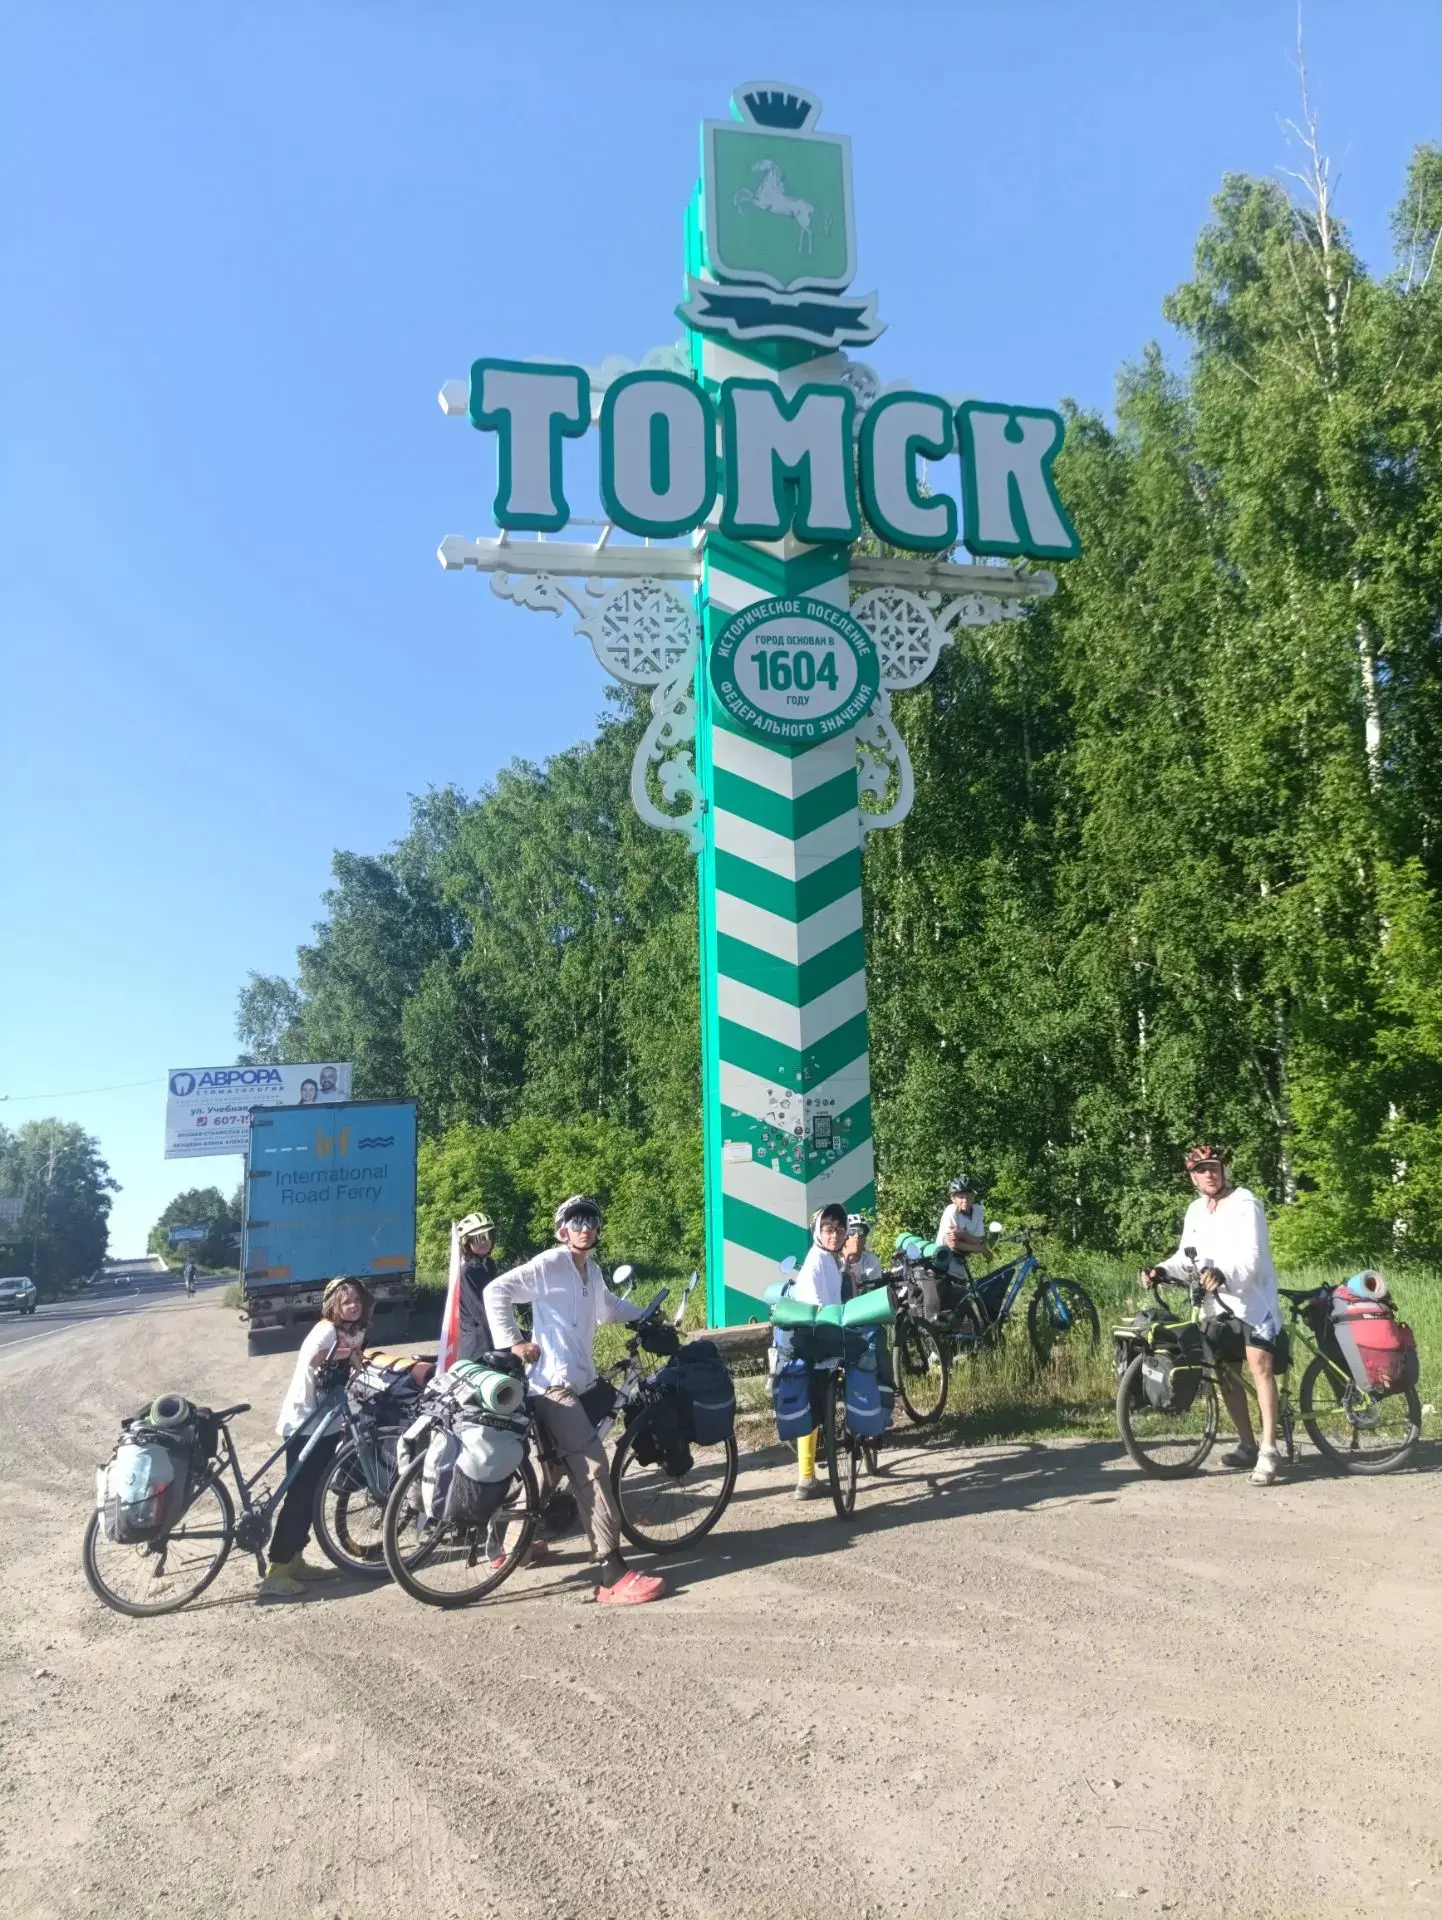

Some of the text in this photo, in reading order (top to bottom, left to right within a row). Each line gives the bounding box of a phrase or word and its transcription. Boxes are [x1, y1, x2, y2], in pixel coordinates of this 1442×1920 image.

[469, 357, 1082, 561] ТОМСК
[717, 601, 871, 658] ИСТОРИЧЕСКОЕ ПОСЕЛЕНИЕ
[755, 635, 835, 646] ГОРОД ОСНОВАН В
[751, 650, 839, 692] 1604
[720, 681, 872, 737] ФЕДЕРАЛЬНОГО ЗНАЧЕНИЯ
[786, 695, 810, 706] ГОДУ
[198, 1068, 283, 1087] АВРОРА
[196, 1085, 285, 1096] СТОМАТОЛОГИЯ
[276, 1163, 389, 1187] International
[281, 1184, 383, 1205] Road Ferry
